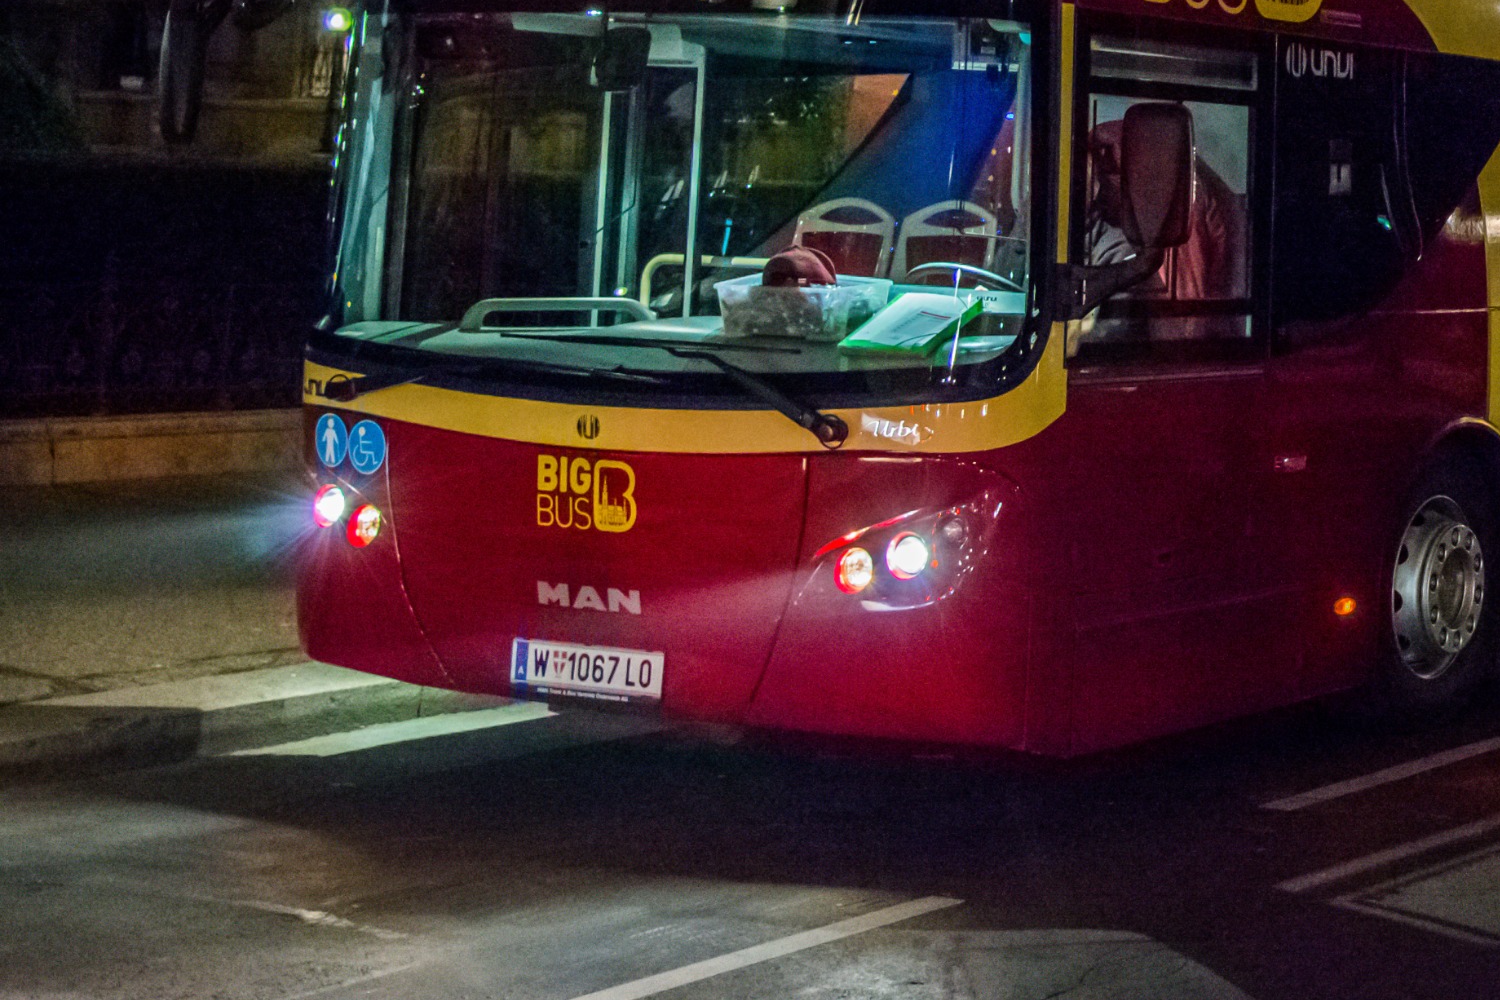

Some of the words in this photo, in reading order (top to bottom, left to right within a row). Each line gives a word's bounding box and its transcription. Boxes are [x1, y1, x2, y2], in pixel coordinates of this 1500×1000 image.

[537, 454, 591, 494] BIG
[537, 493, 591, 530] BUS
[537, 580, 642, 615] MAN
[534, 648, 549, 677] W
